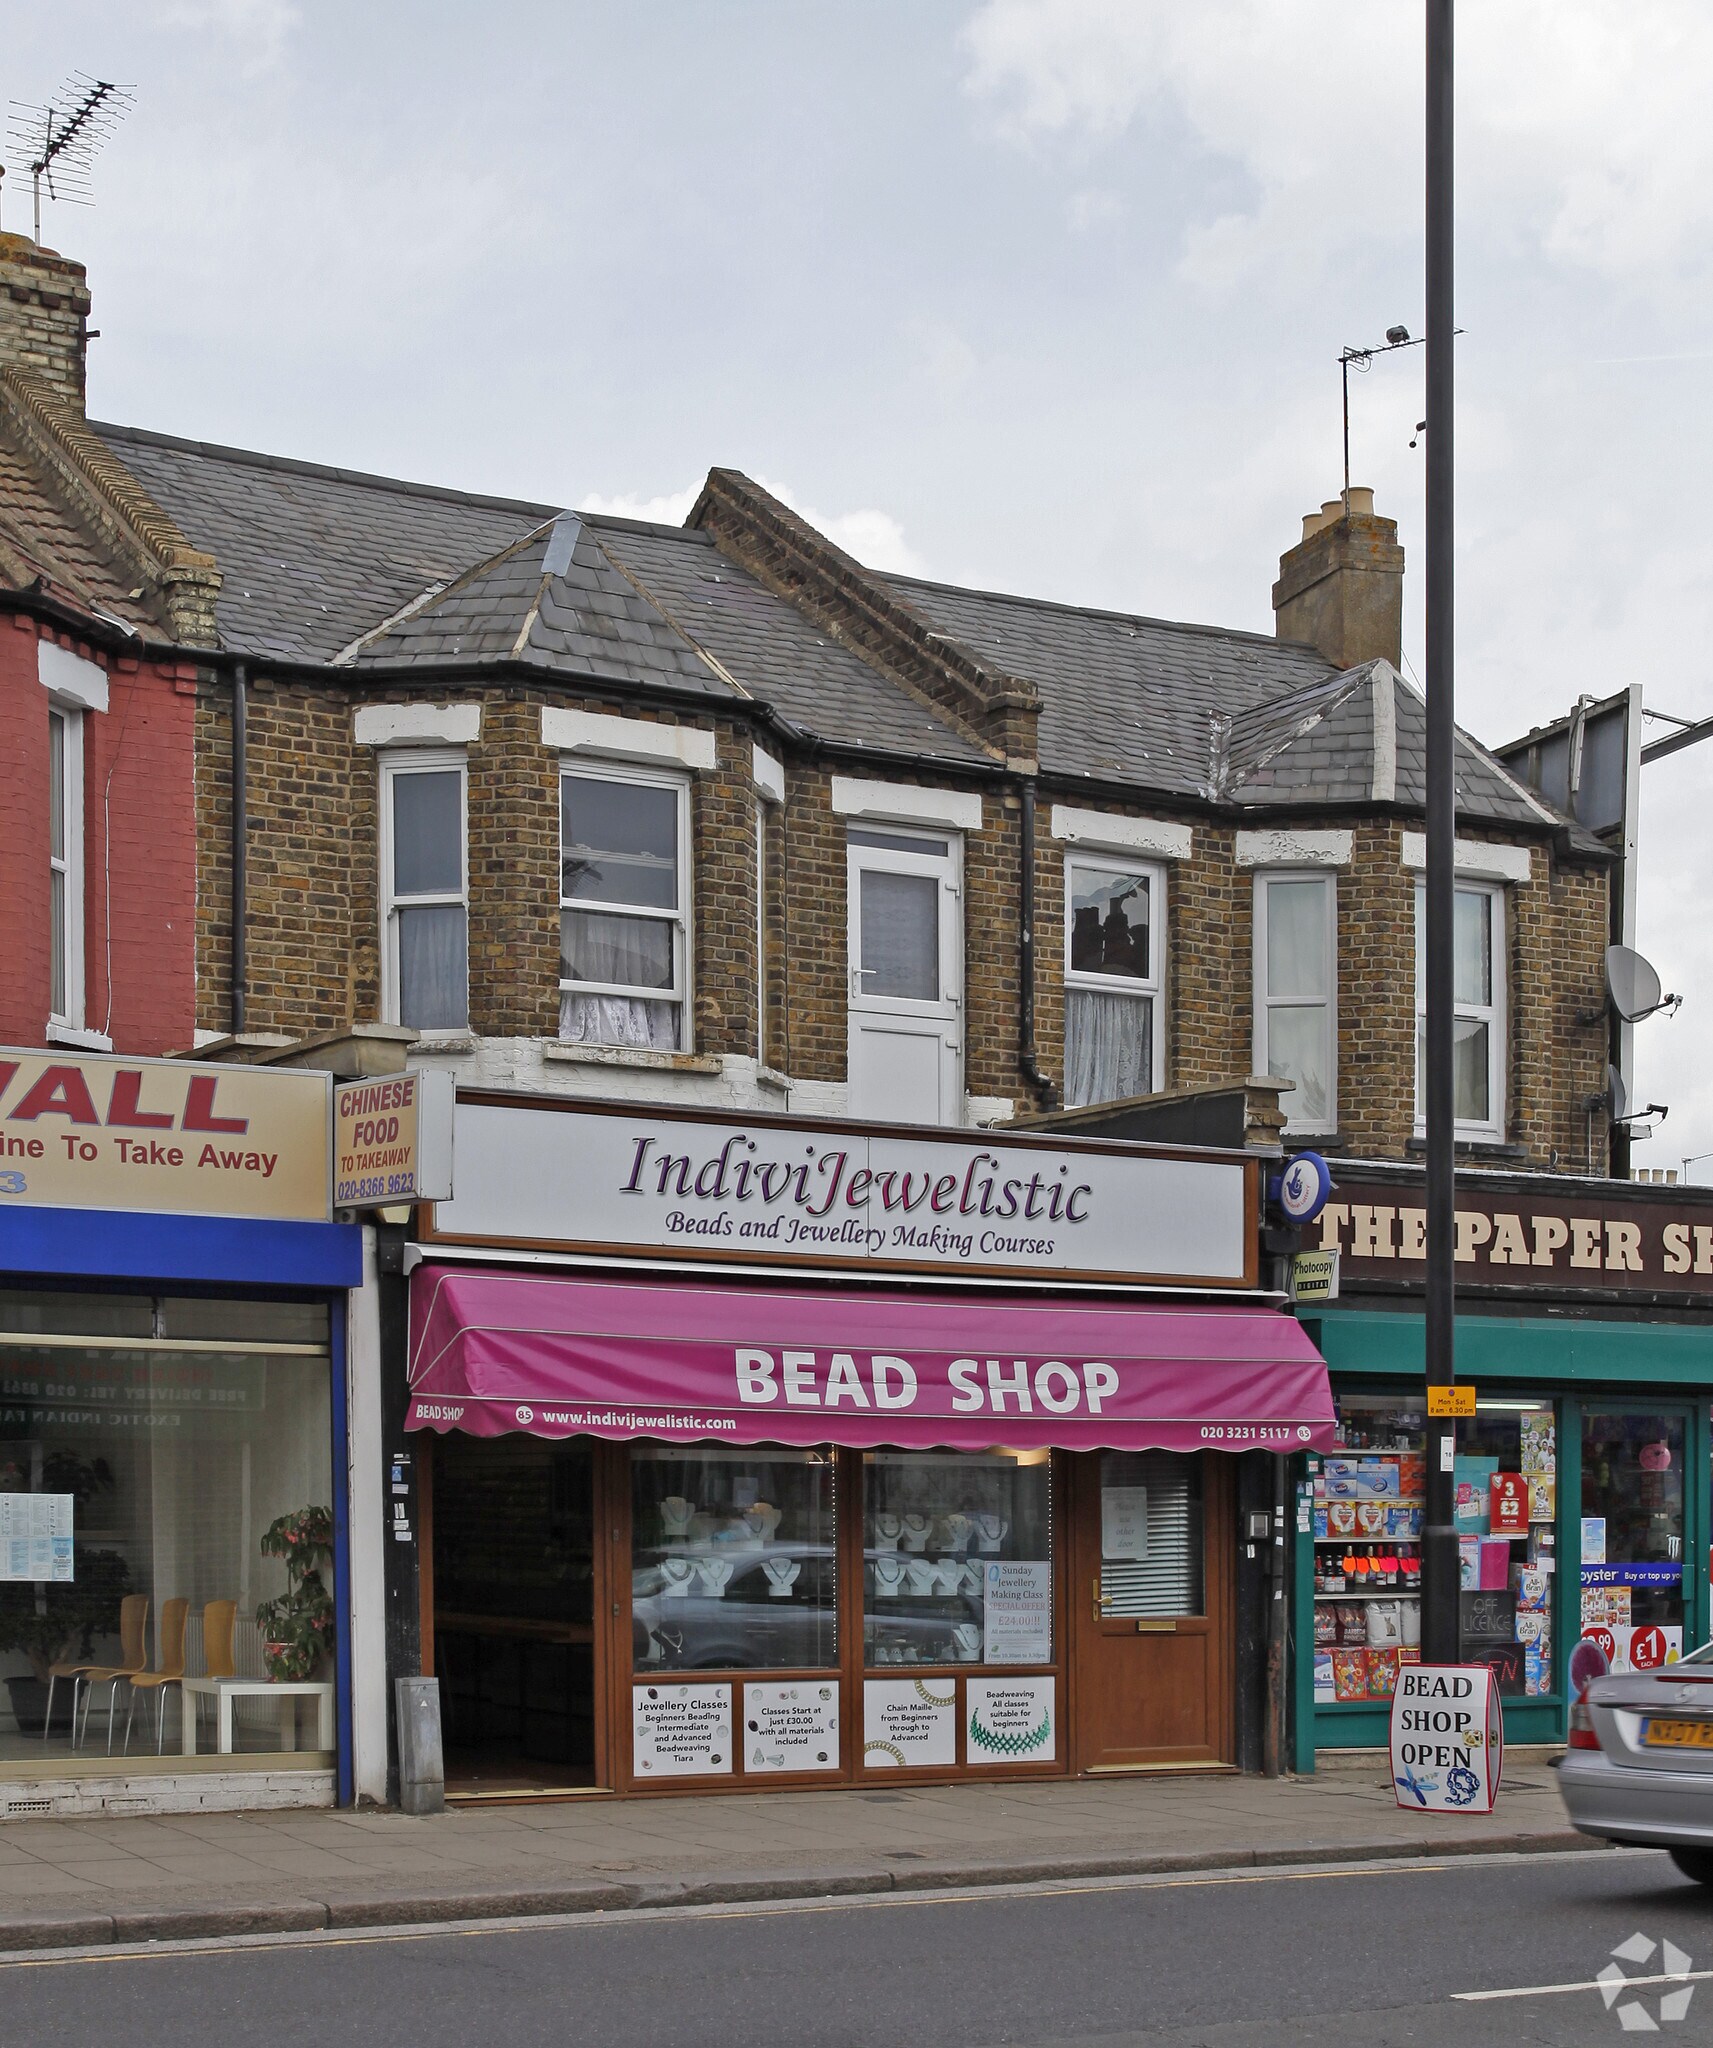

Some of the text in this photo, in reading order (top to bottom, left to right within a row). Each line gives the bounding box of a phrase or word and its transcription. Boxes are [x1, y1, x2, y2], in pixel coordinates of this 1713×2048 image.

[0, 1062, 249, 1135] ALL
[341, 1080, 414, 1118] CHINESE
[353, 1116, 399, 1148] FOOD
[61, 1135, 98, 1161] To
[114, 1138, 184, 1167] Take
[198, 1143, 278, 1177] Away
[341, 1146, 411, 1173] TO TAKEAWAY
[619, 1133, 1091, 1222] IndiviJewelistic
[338, 1172, 414, 1201] 020-8366 9623
[665, 1210, 1055, 1257] Beads and Jewellery Making Courses
[1312, 1203, 1426, 1259] THE
[1453, 1211, 1644, 1272] PAPER
[1294, 1260, 1333, 1275] Photocopy
[1298, 1280, 1328, 1291] DIGITAL
[735, 1348, 1120, 1414] BEAD SHOP
[416, 1404, 465, 1421] BEAD SHOP
[518, 1410, 532, 1421] 85
[542, 1408, 737, 1430] www.indivijewelistic.com
[1200, 1426, 1290, 1440] 020 3231 5117
[1505, 1481, 1515, 1496] 3
[1500, 1500, 1519, 1516] £2
[1001, 1566, 1033, 1577] Sunday
[1624, 1572, 1637, 1581] Buy
[1648, 1572, 1660, 1581] top
[1661, 1573, 1671, 1581] up
[998, 1578, 1037, 1589] Jewellery
[991, 1590, 1044, 1600] Making Class
[1473, 1598, 1498, 1615] OFF
[1462, 1614, 1512, 1632] LICENCE
[1636, 1630, 1657, 1660] £1
[1402, 1675, 1473, 1698] BEAD
[986, 1691, 1035, 1699] Beadweaving
[637, 1700, 728, 1712] Jewellery Classes
[886, 1704, 908, 1712] Chain
[645, 1712, 720, 1723] Beginners Beading
[881, 1713, 938, 1723] from Beginners
[989, 1709, 1032, 1718] suitable for
[769, 1716, 813, 1726] just £30.00
[992, 1719, 1029, 1728] beginners
[1401, 1709, 1472, 1732] SHOP
[656, 1723, 709, 1732] Intermediate
[758, 1726, 825, 1736] with all materials
[889, 1723, 930, 1733] through to
[654, 1733, 712, 1742] and Advanced
[775, 1737, 808, 1745] included
[890, 1733, 929, 1741] Advanced
[656, 1744, 710, 1754] Beadweaving
[1401, 1743, 1472, 1768] OPEN
[673, 1754, 694, 1762] Tiara
